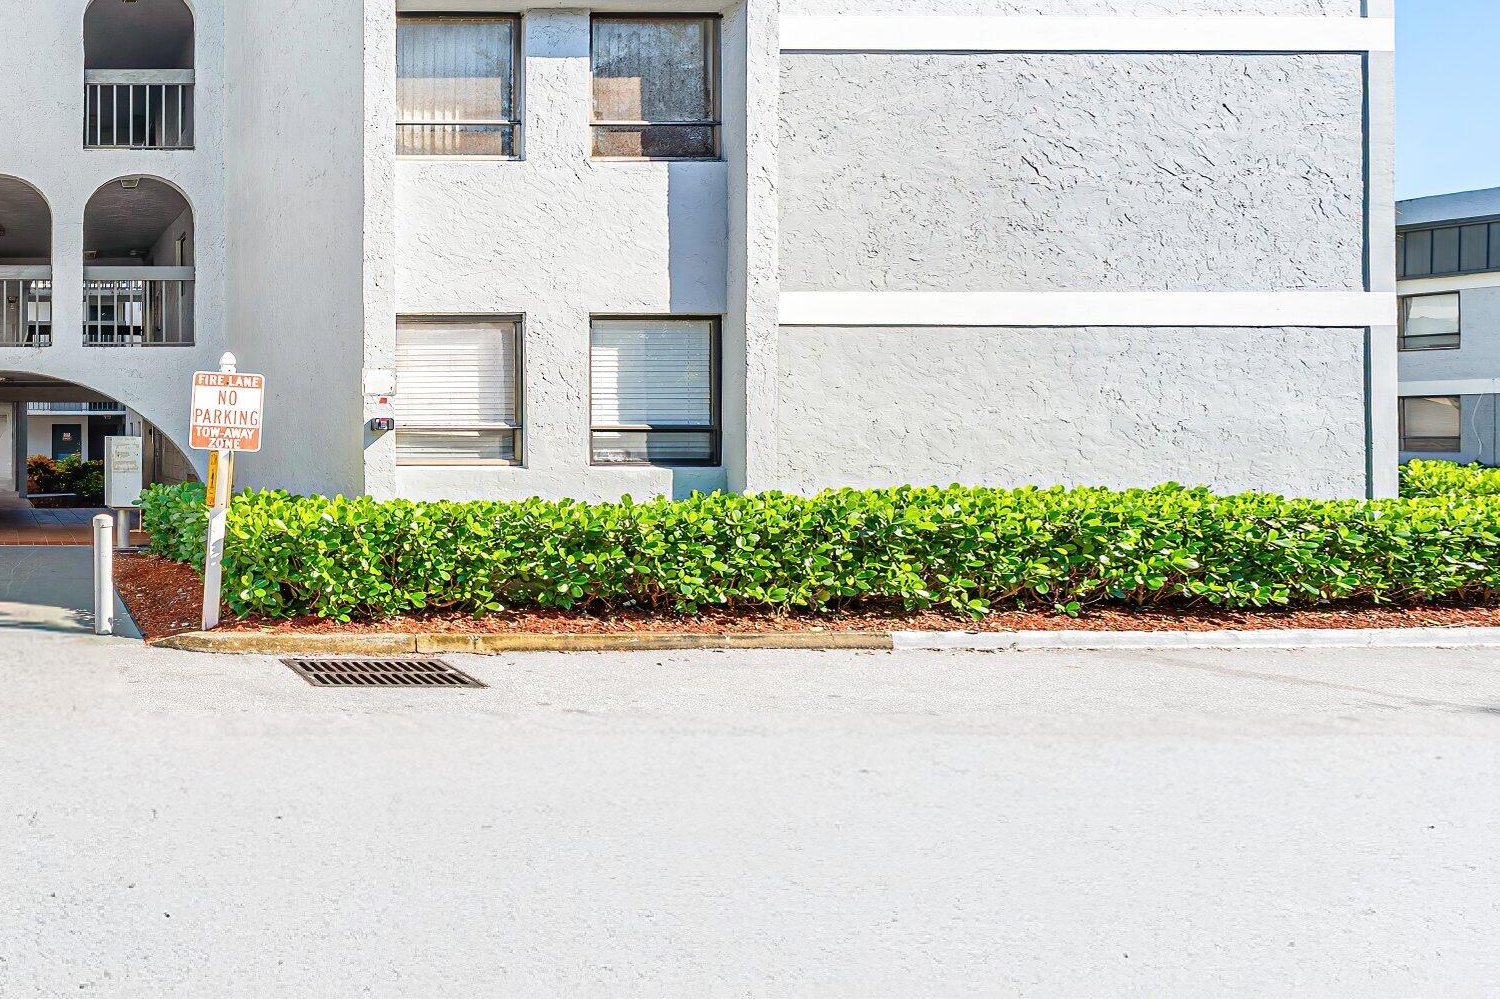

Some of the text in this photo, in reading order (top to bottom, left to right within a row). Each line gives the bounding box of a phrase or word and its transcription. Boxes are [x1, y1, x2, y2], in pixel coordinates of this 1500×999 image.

[199, 374, 259, 387] FIRE LANE
[218, 390, 237, 405] NO
[195, 409, 258, 426] PARKING
[196, 427, 255, 439] TOW-AWAY
[208, 438, 241, 449] ZONE
